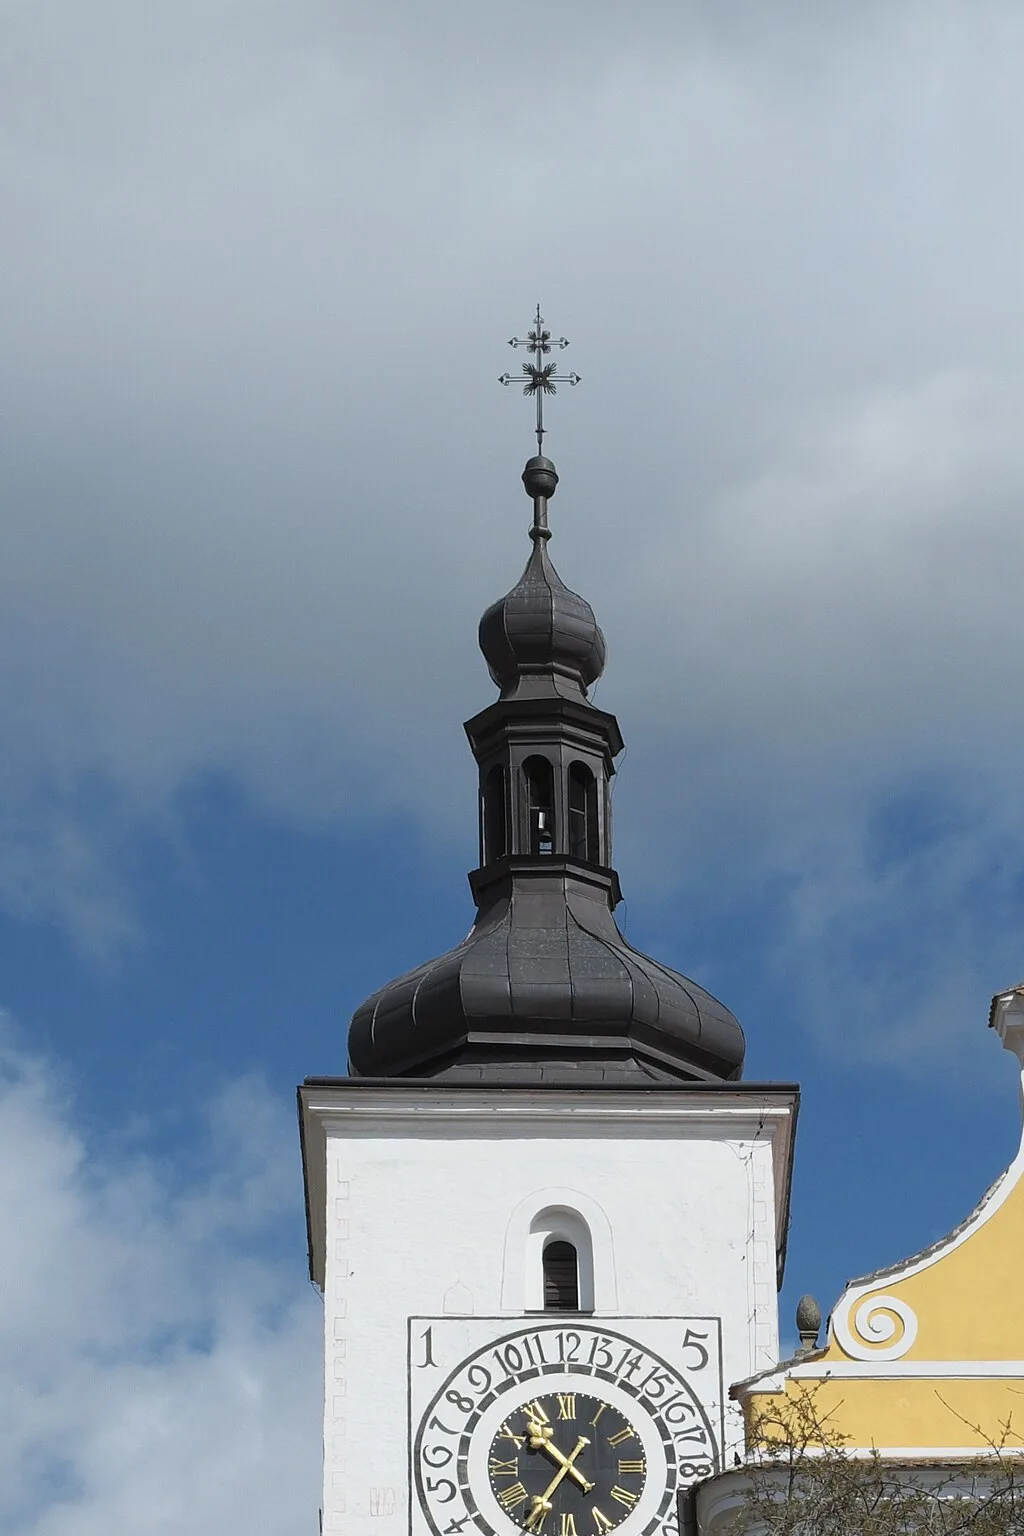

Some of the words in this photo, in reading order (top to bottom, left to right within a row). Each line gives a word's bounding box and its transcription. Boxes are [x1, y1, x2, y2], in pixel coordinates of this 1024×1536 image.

[416, 1325, 439, 1368] 1
[521, 1333, 548, 1368] 11
[555, 1332, 581, 1363] 12
[587, 1336, 613, 1369] 13
[682, 1328, 709, 1371] 5
[492, 1344, 523, 1378] 10
[613, 1348, 645, 1381] 14
[468, 1365, 491, 1395] 9
[637, 1365, 675, 1398] 15
[445, 1390, 475, 1413] 8
[556, 1395, 577, 1420] XII
[655, 1389, 696, 1424] 16
[429, 1415, 461, 1435] 7
[499, 1425, 527, 1450] X
[607, 1426, 635, 1449] II
[673, 1424, 708, 1445] 17
[423, 1445, 453, 1468] 6
[489, 1457, 518, 1477] IX
[618, 1460, 645, 1475] III
[678, 1452, 713, 1478] 18
[426, 1476, 457, 1503] 5
[443, 1513, 471, 1535] 4
